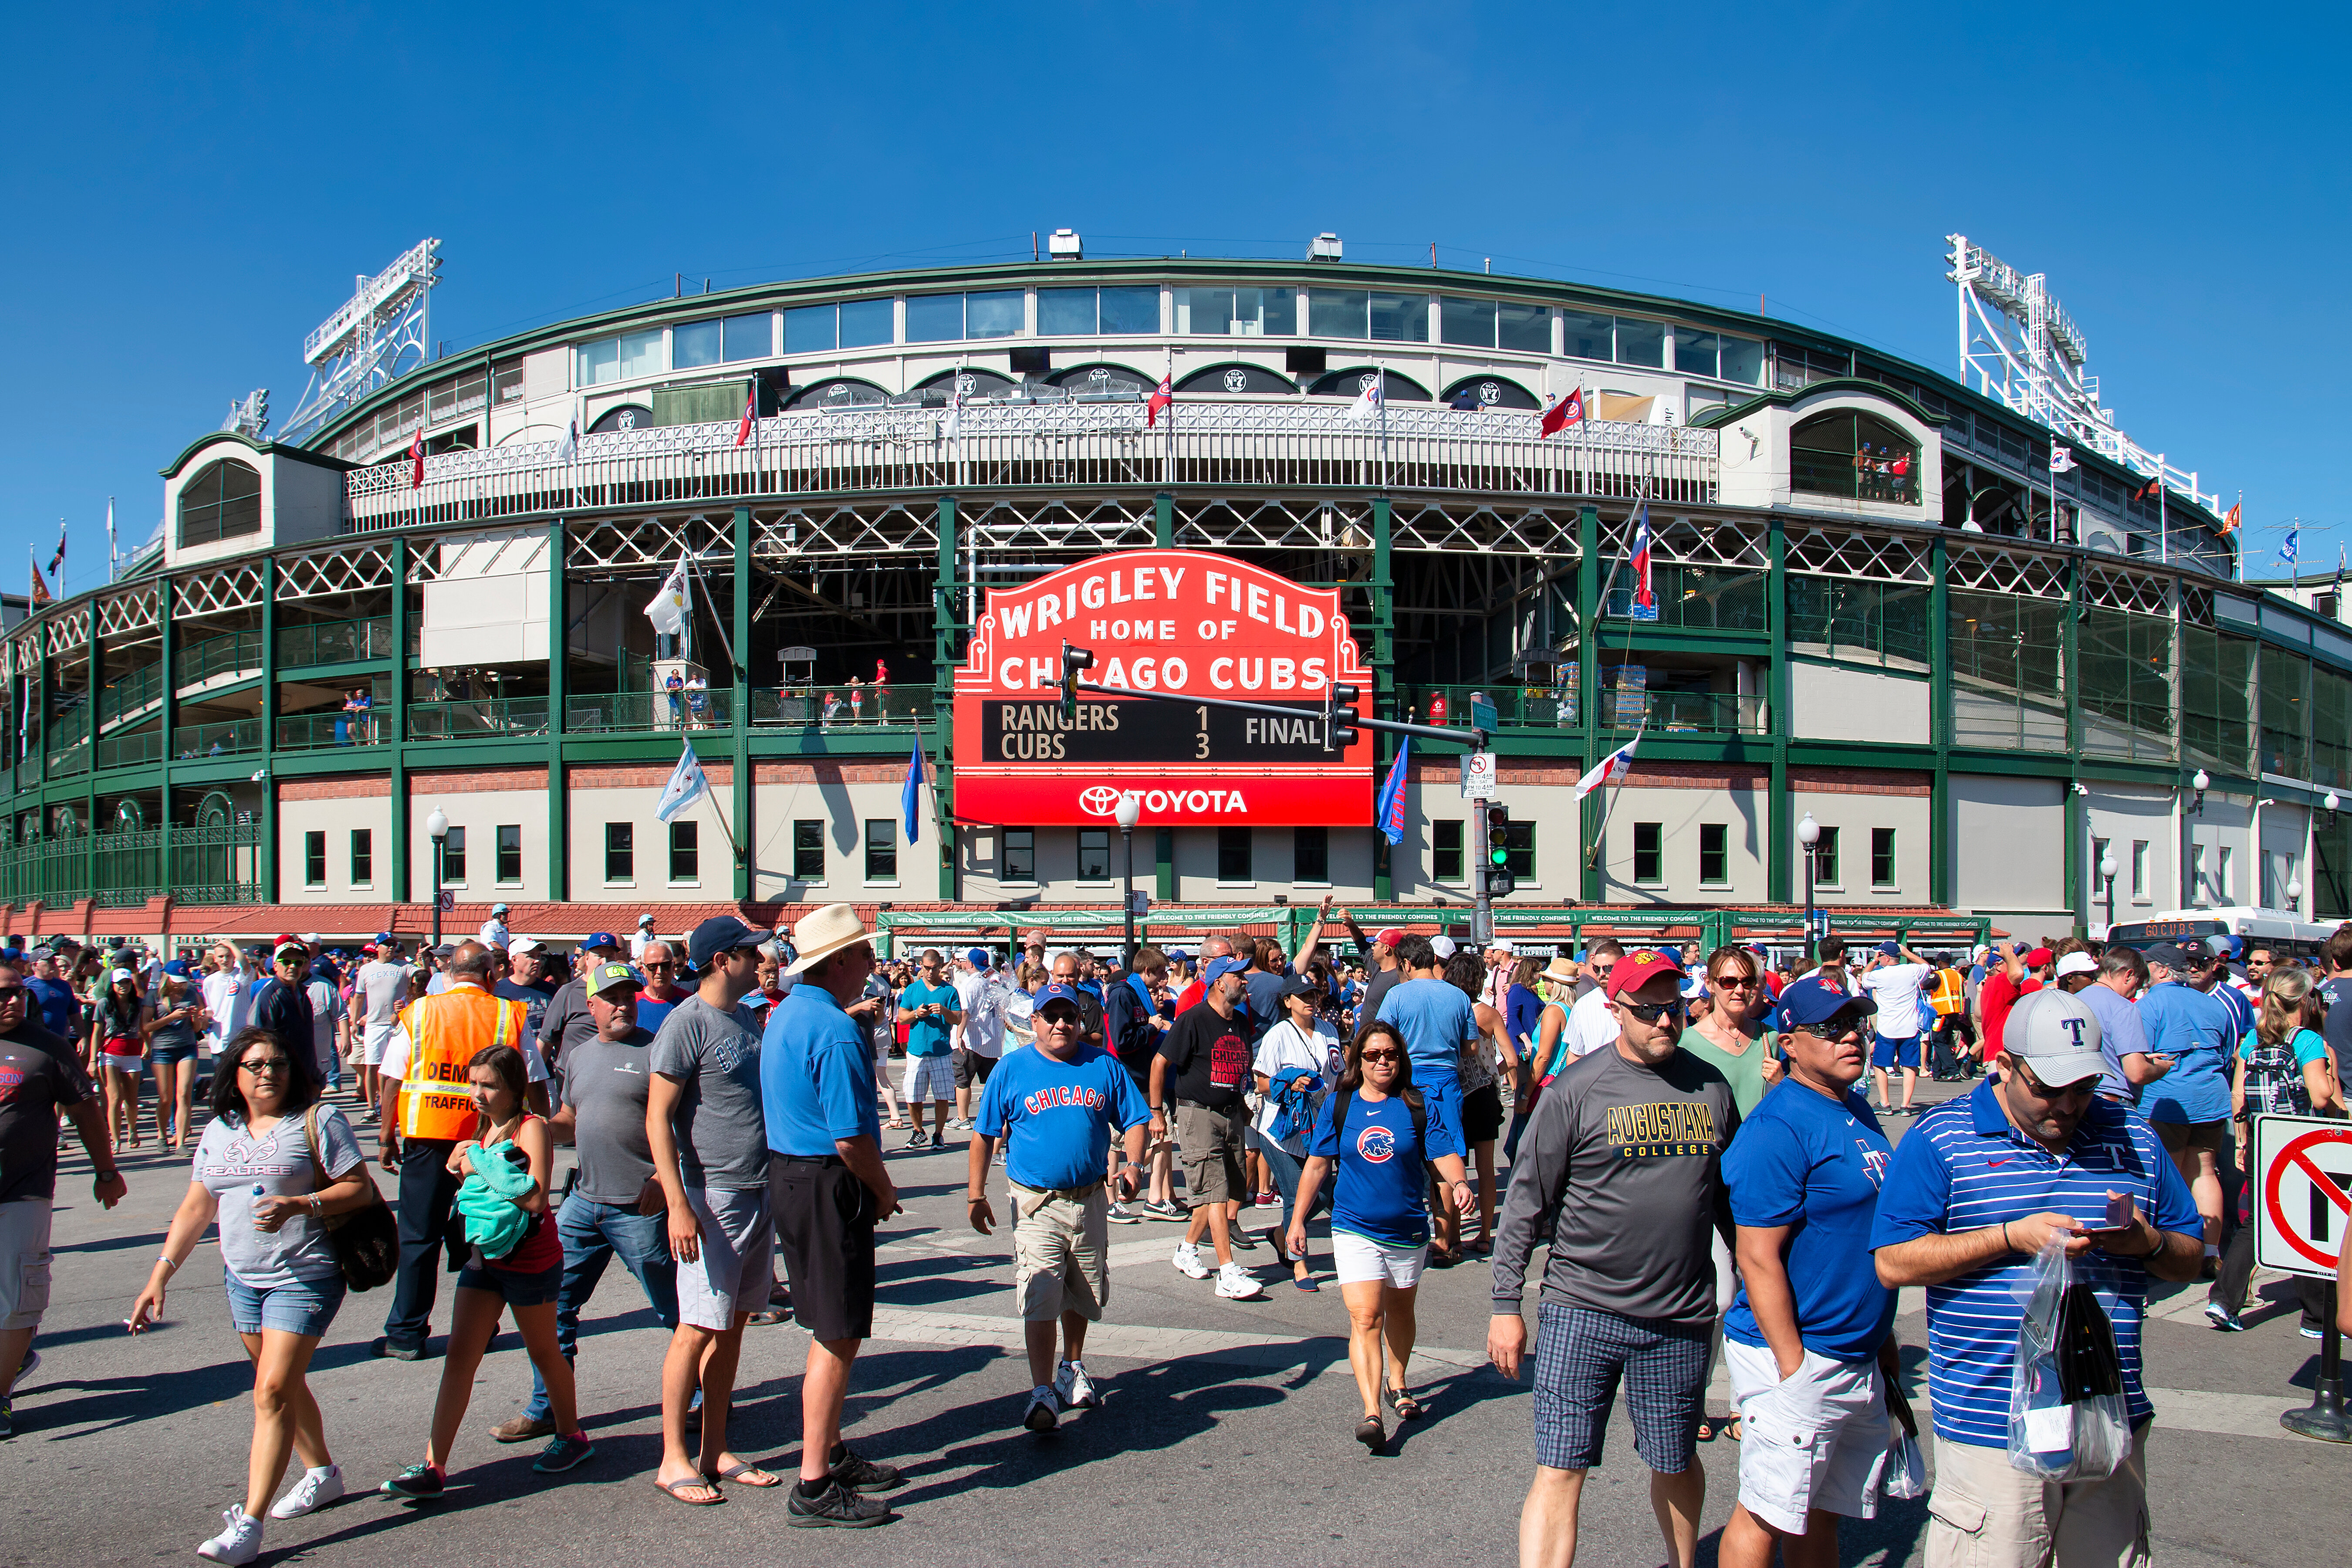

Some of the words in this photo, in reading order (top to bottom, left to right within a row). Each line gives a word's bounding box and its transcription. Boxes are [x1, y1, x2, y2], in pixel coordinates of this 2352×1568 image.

[1665, 408, 1674, 426] JAC
[1000, 567, 1185, 639] WRIGLEY
[1206, 571, 1325, 639] FIELD
[1091, 620, 1175, 640] HOME
[1198, 620, 1237, 640] OF
[1000, 657, 1188, 690] CHCAGO
[1211, 657, 1326, 690] CUBS
[1196, 706, 1207, 730] 1
[1246, 718, 1321, 744] FINAL
[1002, 733, 1065, 759] CUBS
[1196, 734, 1210, 759] 3
[1131, 790, 1247, 813] TOYOTA
[2146, 924, 2158, 936] GO
[2160, 922, 2195, 936] CUBS
[370, 970, 401, 980] TEXAS
[1048, 985, 1062, 993] C
[2061, 1017, 2085, 1046] T
[1213, 1050, 1249, 1062] CHICAGO
[1211, 1061, 1243, 1074] WANTS
[1210, 1072, 1241, 1084] MORE
[425, 1096, 477, 1112] TRAFFIC
[1024, 1085, 1105, 1115] CHICAGO
[1608, 1103, 1716, 1145] AUGUSTANA
[1624, 1145, 1708, 1157] COLLEGE
[2102, 1142, 2126, 1169] T
[205, 1164, 293, 1177] REALTREE
